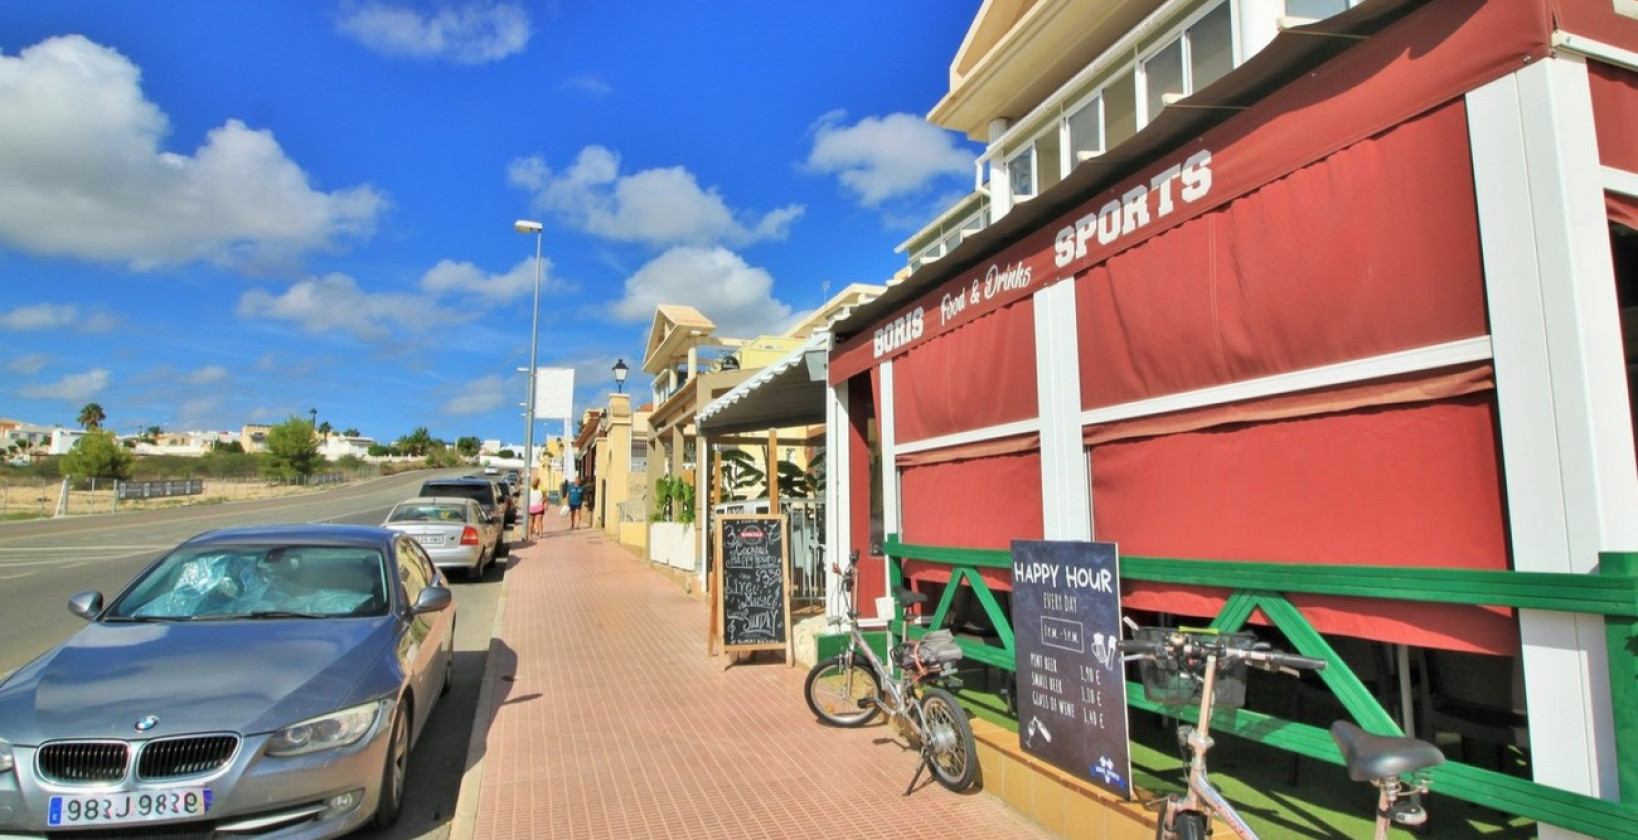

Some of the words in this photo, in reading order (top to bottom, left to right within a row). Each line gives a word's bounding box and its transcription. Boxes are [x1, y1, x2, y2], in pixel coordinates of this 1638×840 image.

[873, 306, 924, 358] BORIS
[940, 288, 966, 326] Food
[970, 278, 980, 305] &
[984, 261, 1032, 299] Drinks
[1055, 149, 1212, 268] SPORTS
[1013, 561, 1059, 588] HAPPY
[1065, 564, 1113, 594] HOUR
[1043, 592, 1062, 611] EVERY
[1064, 593, 1077, 614] DAY
[1030, 652, 1043, 669] PINT
[1044, 656, 1057, 673] BEER
[1031, 671, 1048, 690] SMALL
[1049, 677, 1063, 695] BEER
[1095, 669, 1101, 686] €
[1032, 690, 1049, 709] GLASS
[1050, 696, 1057, 712] OF
[1059, 699, 1075, 719] WINE
[1096, 690, 1102, 707] €
[1099, 712, 1105, 729] €
